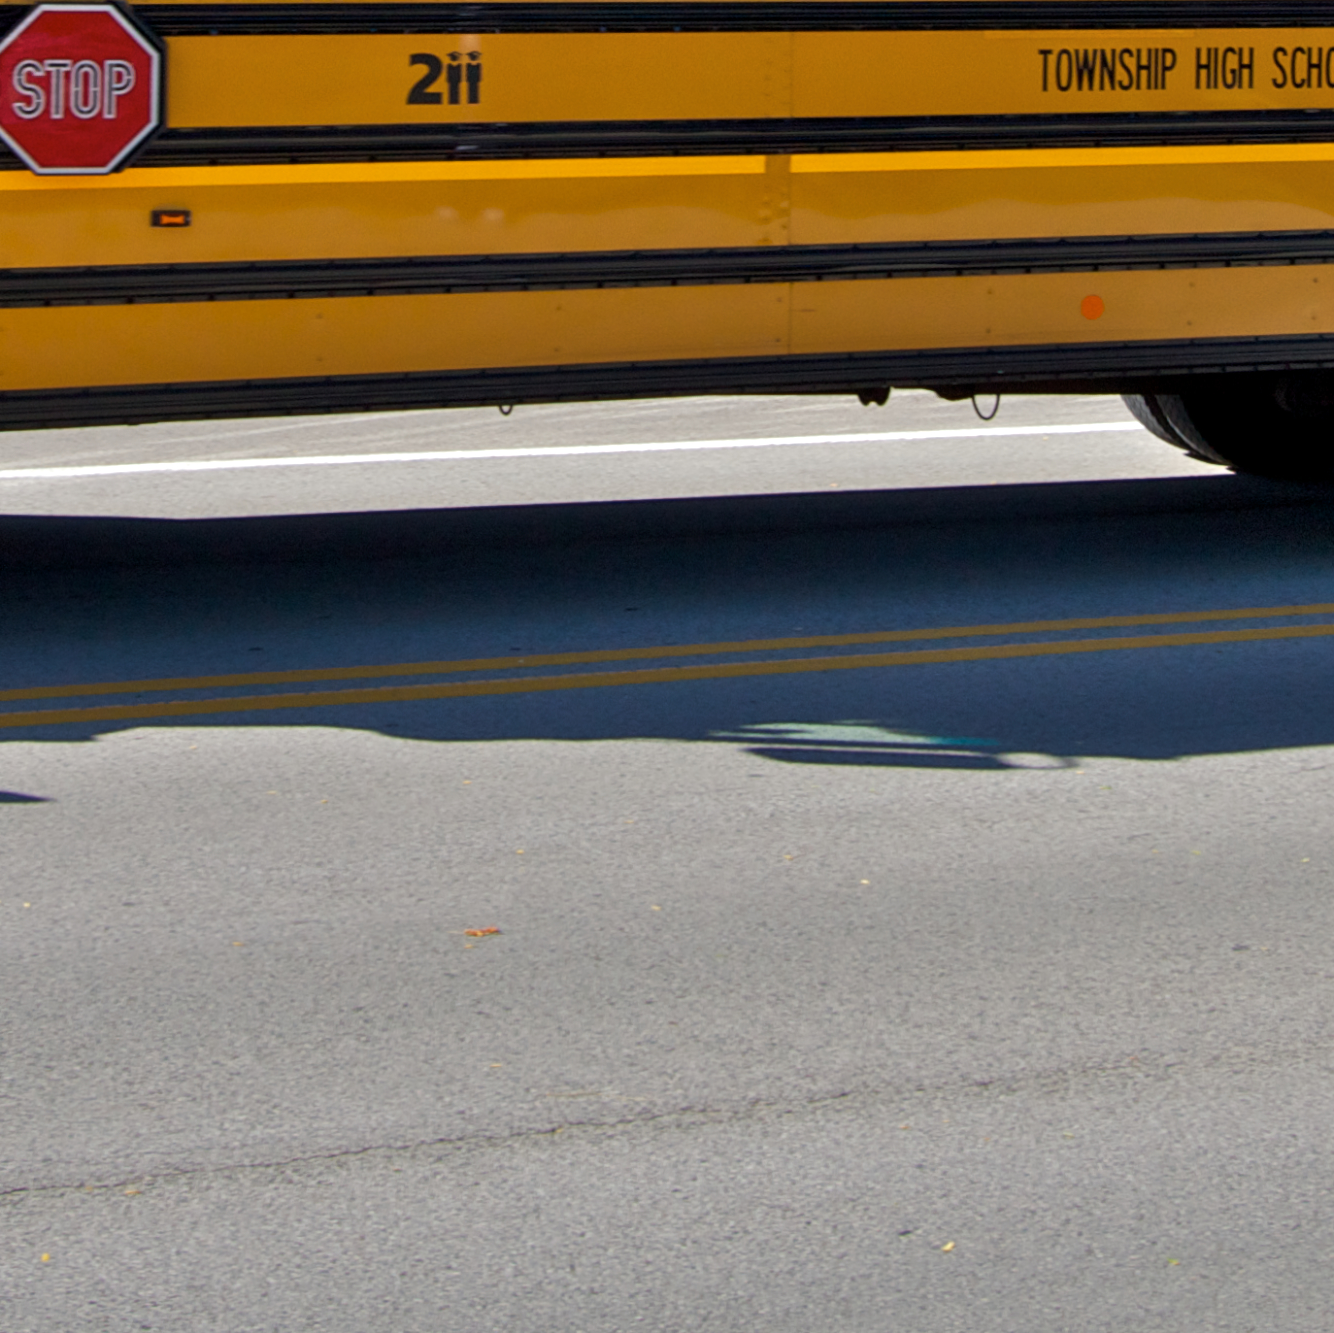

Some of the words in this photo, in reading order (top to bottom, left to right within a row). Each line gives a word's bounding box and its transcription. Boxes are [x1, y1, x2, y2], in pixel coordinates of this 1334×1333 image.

[12, 59, 136, 119] STOP
[1037, 47, 1178, 92] TOWNSHIP
[1195, 46, 1255, 90] HIGH
